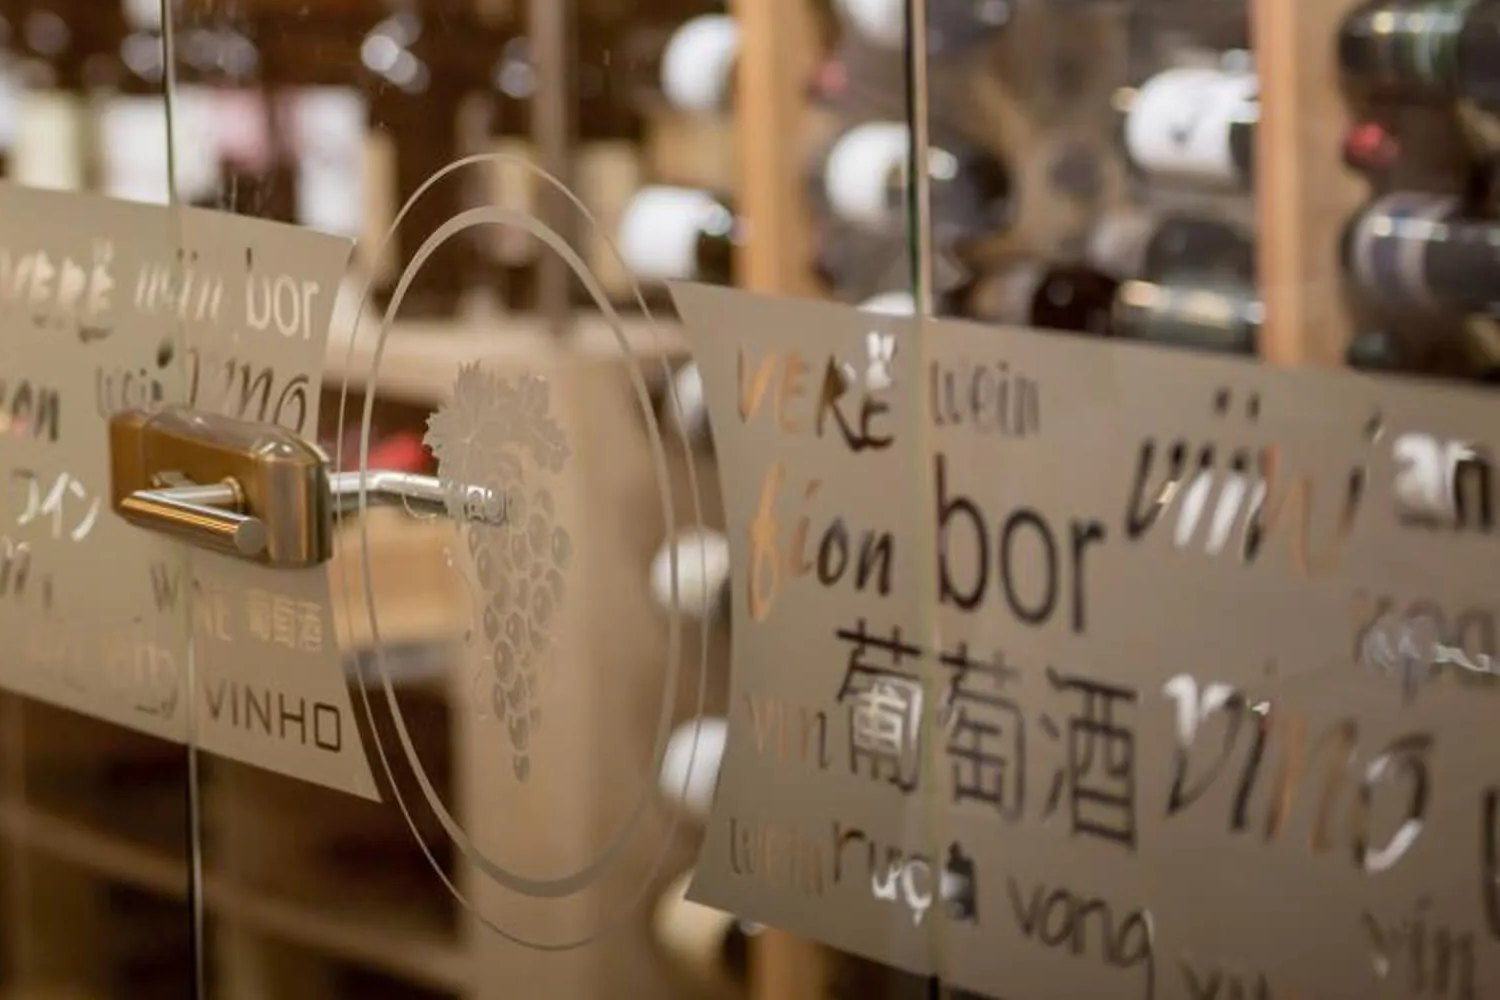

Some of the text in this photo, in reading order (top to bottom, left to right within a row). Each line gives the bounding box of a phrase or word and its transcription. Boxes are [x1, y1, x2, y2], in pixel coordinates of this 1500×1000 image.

[244, 247, 320, 341] bor
[934, 452, 1105, 633] bor
[203, 678, 342, 754] VINHO
[836, 618, 1138, 853] 葡萄酒
